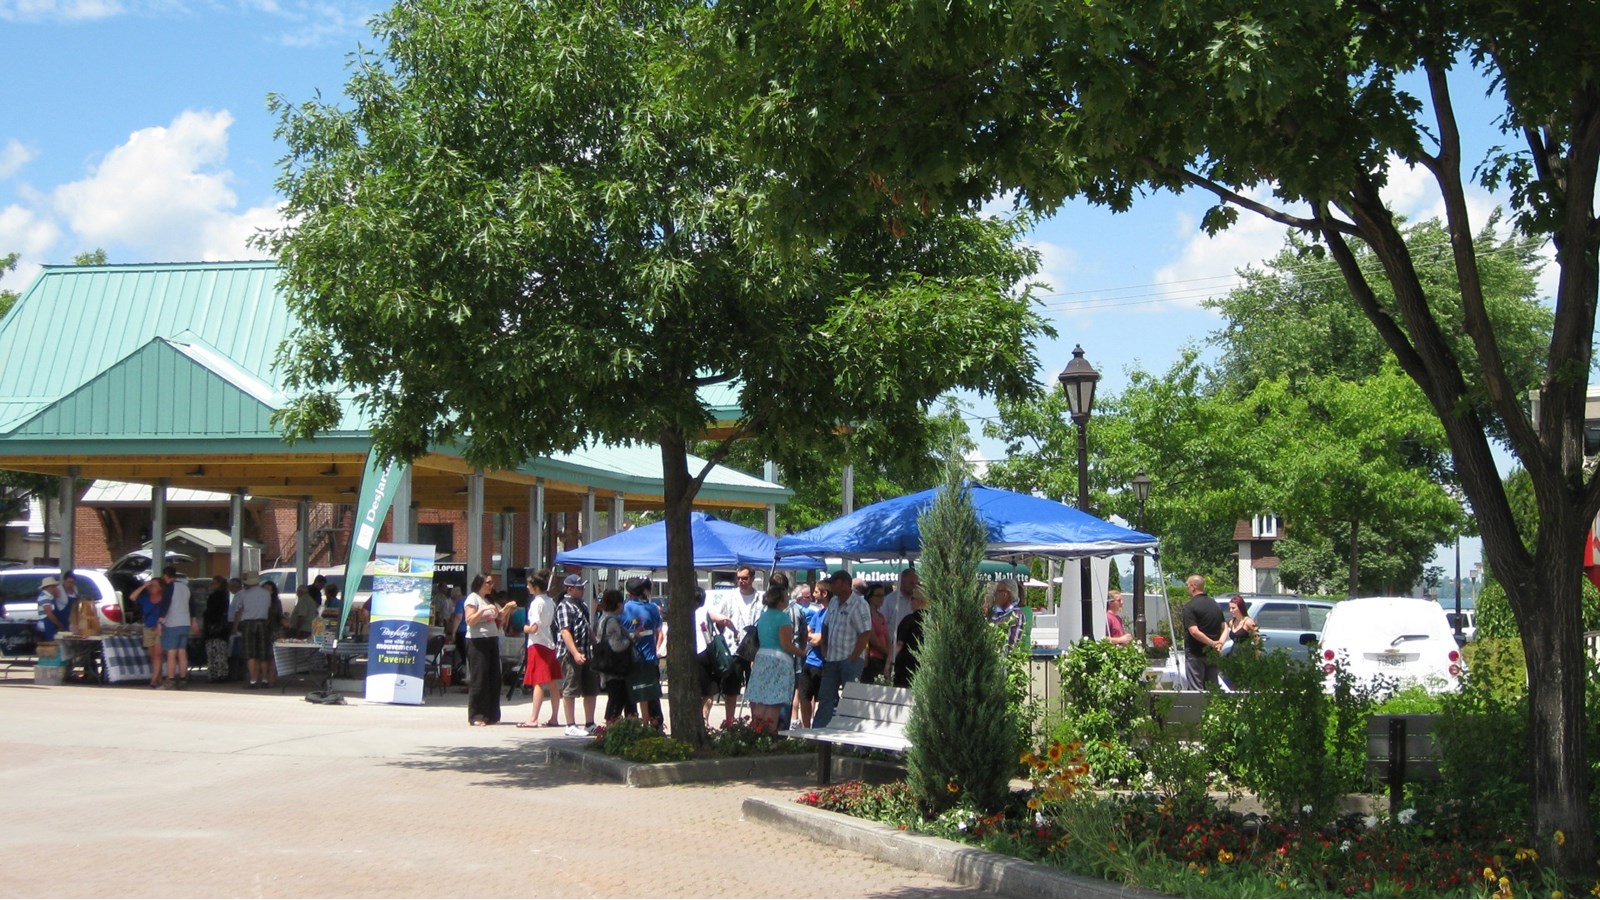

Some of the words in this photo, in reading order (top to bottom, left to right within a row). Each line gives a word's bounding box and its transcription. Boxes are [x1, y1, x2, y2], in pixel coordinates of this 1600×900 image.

[366, 455, 396, 522] Desjar
[994, 571, 1029, 582] Malltte
[378, 654, 415, 665] l'avenir!
